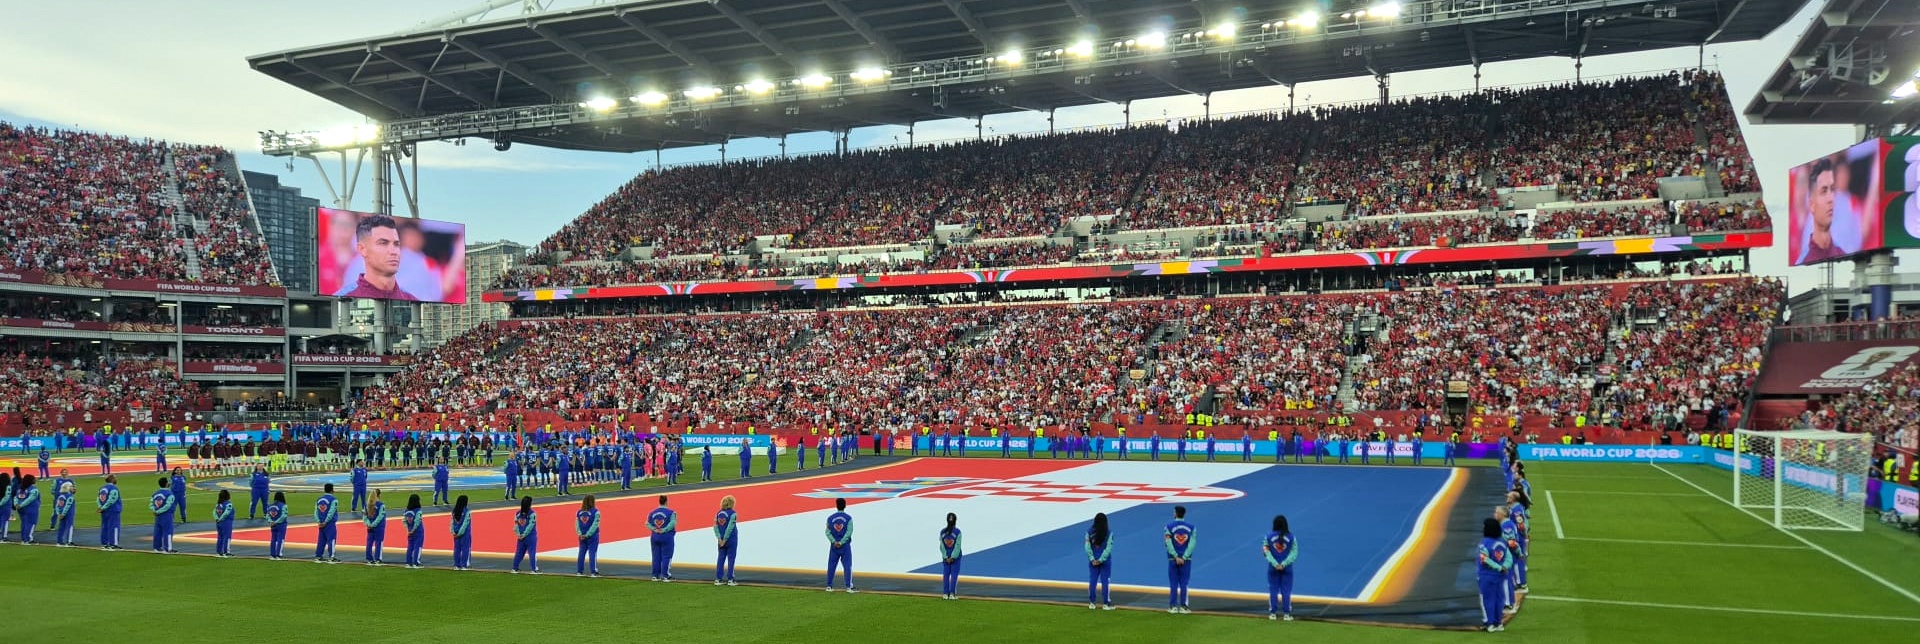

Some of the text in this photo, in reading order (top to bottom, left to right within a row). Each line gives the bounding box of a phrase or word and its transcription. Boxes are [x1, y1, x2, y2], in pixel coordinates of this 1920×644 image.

[206, 326, 264, 334] TORONTO
[689, 436, 711, 444] WORLD
[979, 440, 996, 448] CUP
[1532, 447, 1681, 459] FIFA WORLD CUP 2026
